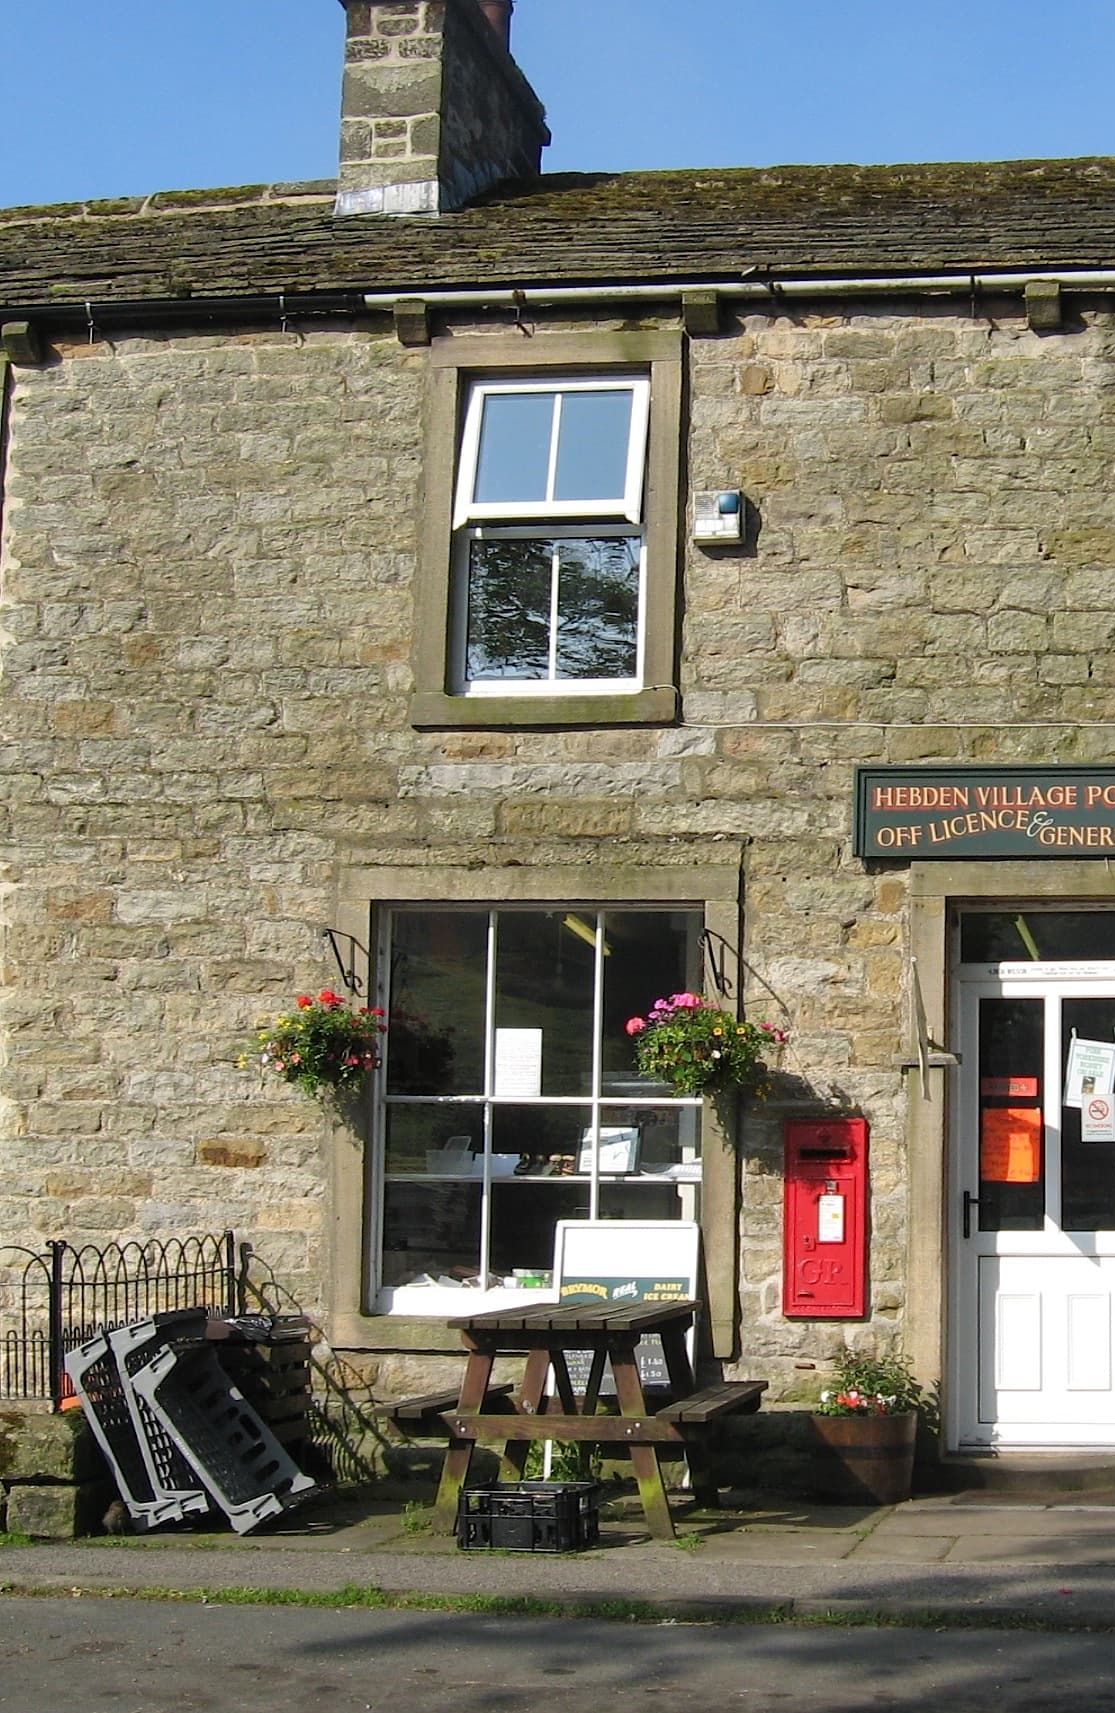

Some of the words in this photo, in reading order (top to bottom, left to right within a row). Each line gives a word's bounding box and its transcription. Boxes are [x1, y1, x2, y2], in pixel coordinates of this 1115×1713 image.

[874, 786, 969, 807] HEBDEN
[977, 786, 1077, 806] VILLAGE
[876, 825, 923, 847] OFF
[929, 808, 1031, 843] LICENCE
[1026, 811, 1055, 838] &
[612, 1281, 638, 1300] REAL
[654, 1283, 683, 1291] DAIRY
